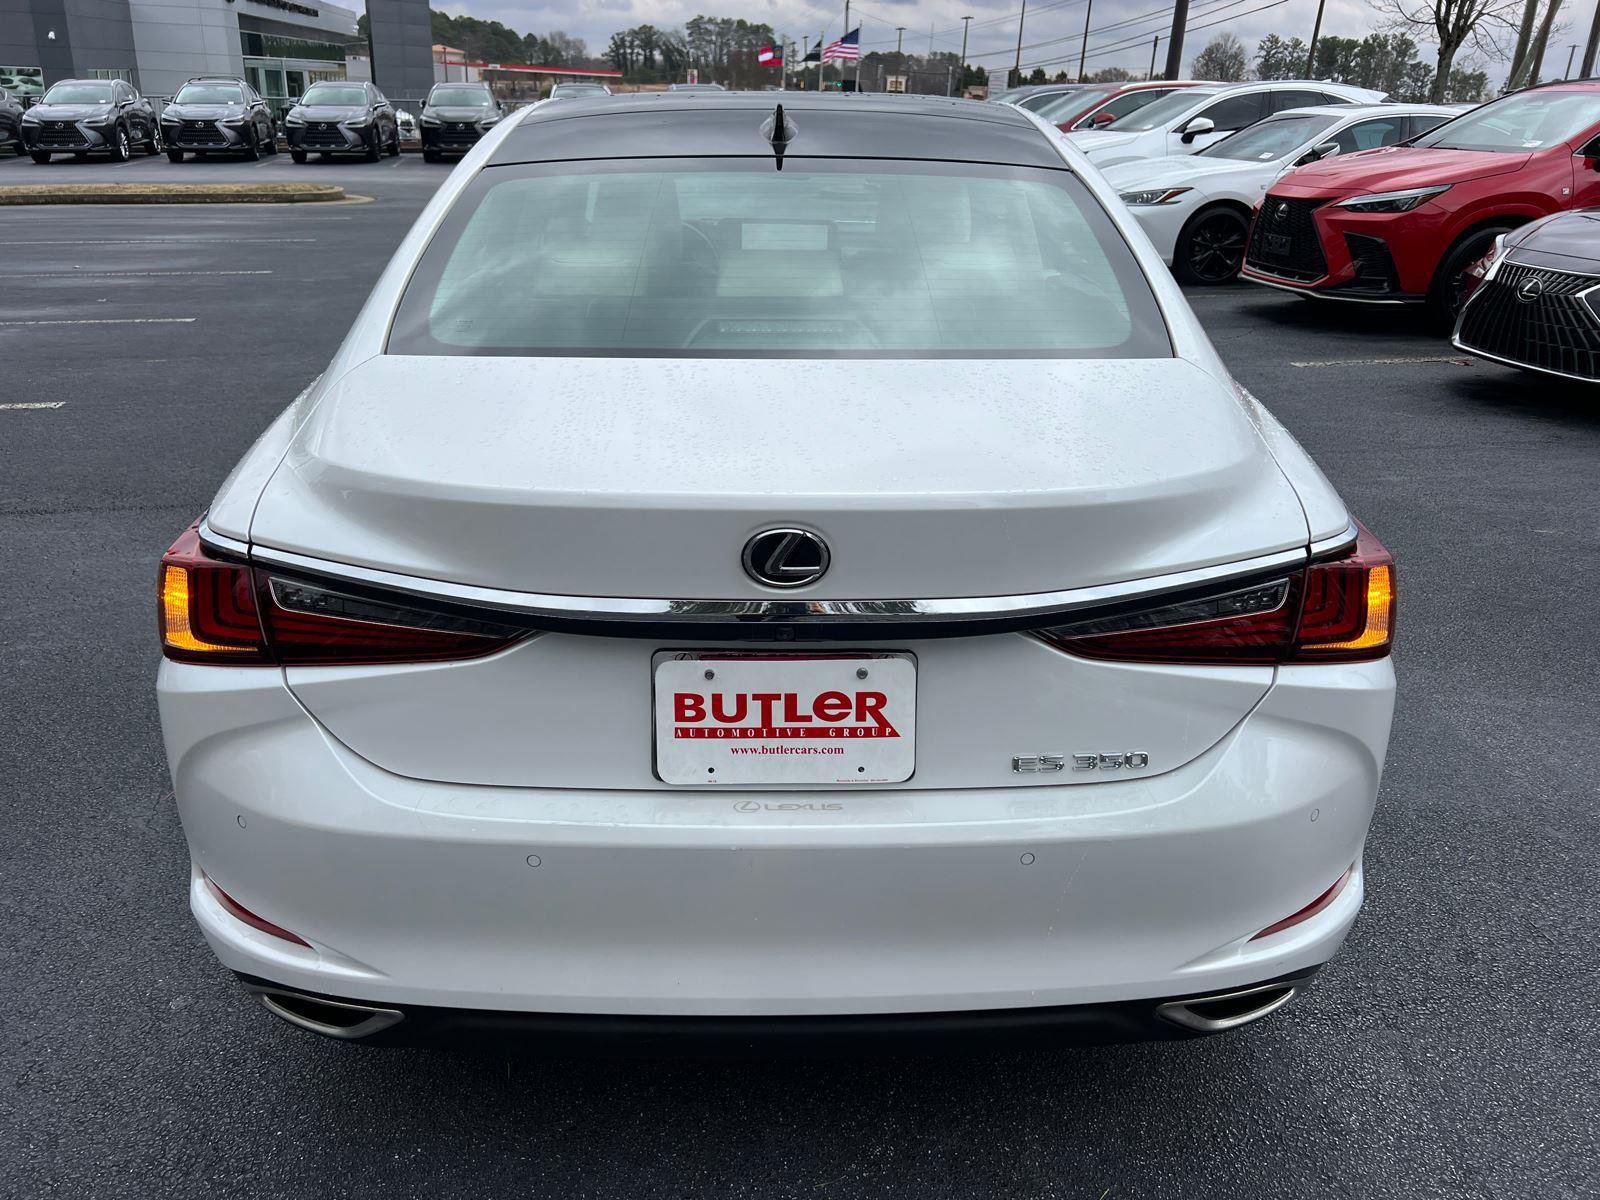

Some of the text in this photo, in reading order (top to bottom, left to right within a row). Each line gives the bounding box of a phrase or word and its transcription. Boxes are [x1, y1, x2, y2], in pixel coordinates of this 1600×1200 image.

[675, 727, 892, 738] AUTOMOTIVE GROUP
[730, 745, 845, 755] www.butlercars.com
[1011, 751, 1149, 773] ES 350
[764, 803, 844, 811] LEXUS
